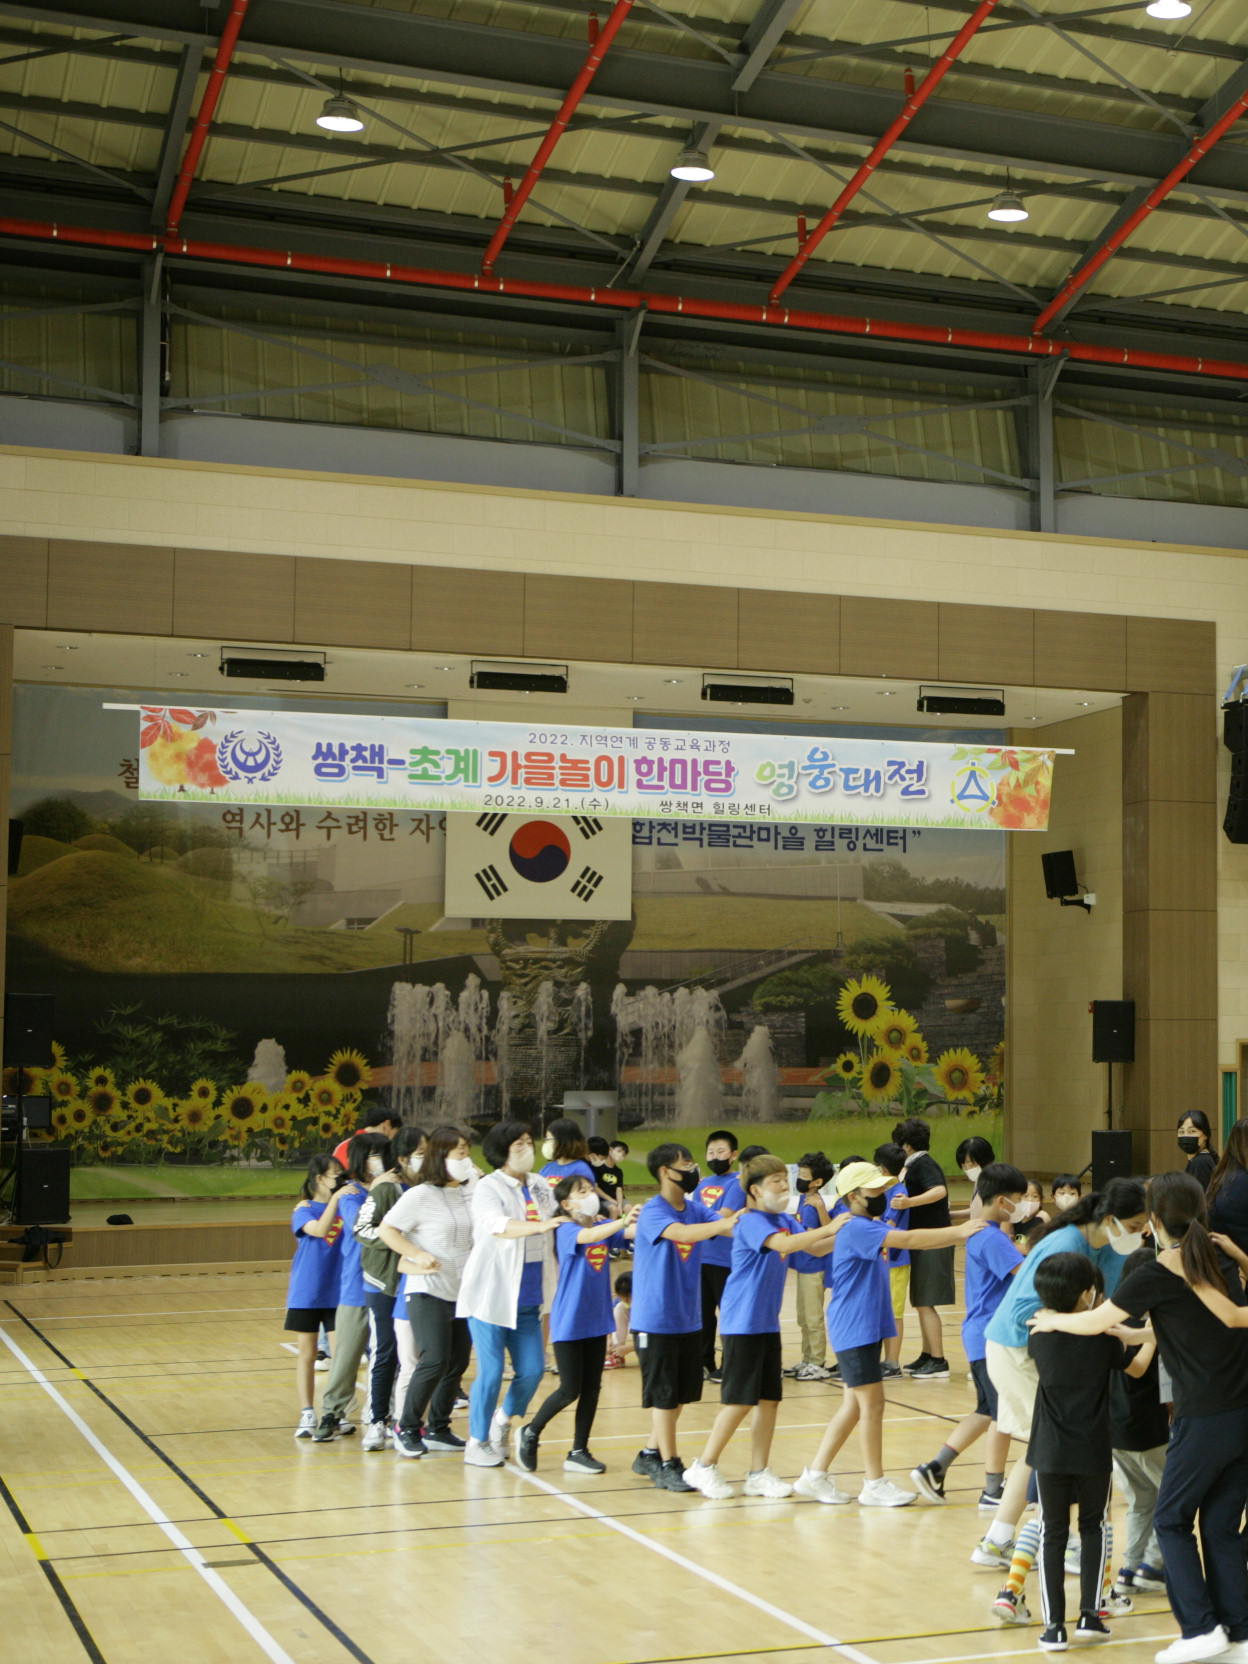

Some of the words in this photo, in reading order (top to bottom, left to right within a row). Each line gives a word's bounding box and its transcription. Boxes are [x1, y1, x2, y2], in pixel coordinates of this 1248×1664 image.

[528, 732, 575, 746] 2022.
[579, 734, 639, 749] 지역연계
[644, 736, 731, 754] 공동교육과정
[311, 741, 479, 784] 쌍책-초계
[487, 750, 625, 790] 가을놀이
[633, 755, 736, 793] 한마당
[755, 746, 927, 798] 영웅대전
[659, 800, 704, 814] 쌍책면
[712, 801, 771, 816] 힐링센터
[221, 806, 306, 840] 역사와
[315, 810, 399, 842] 수려한
[631, 820, 806, 851] 합천박물관마을
